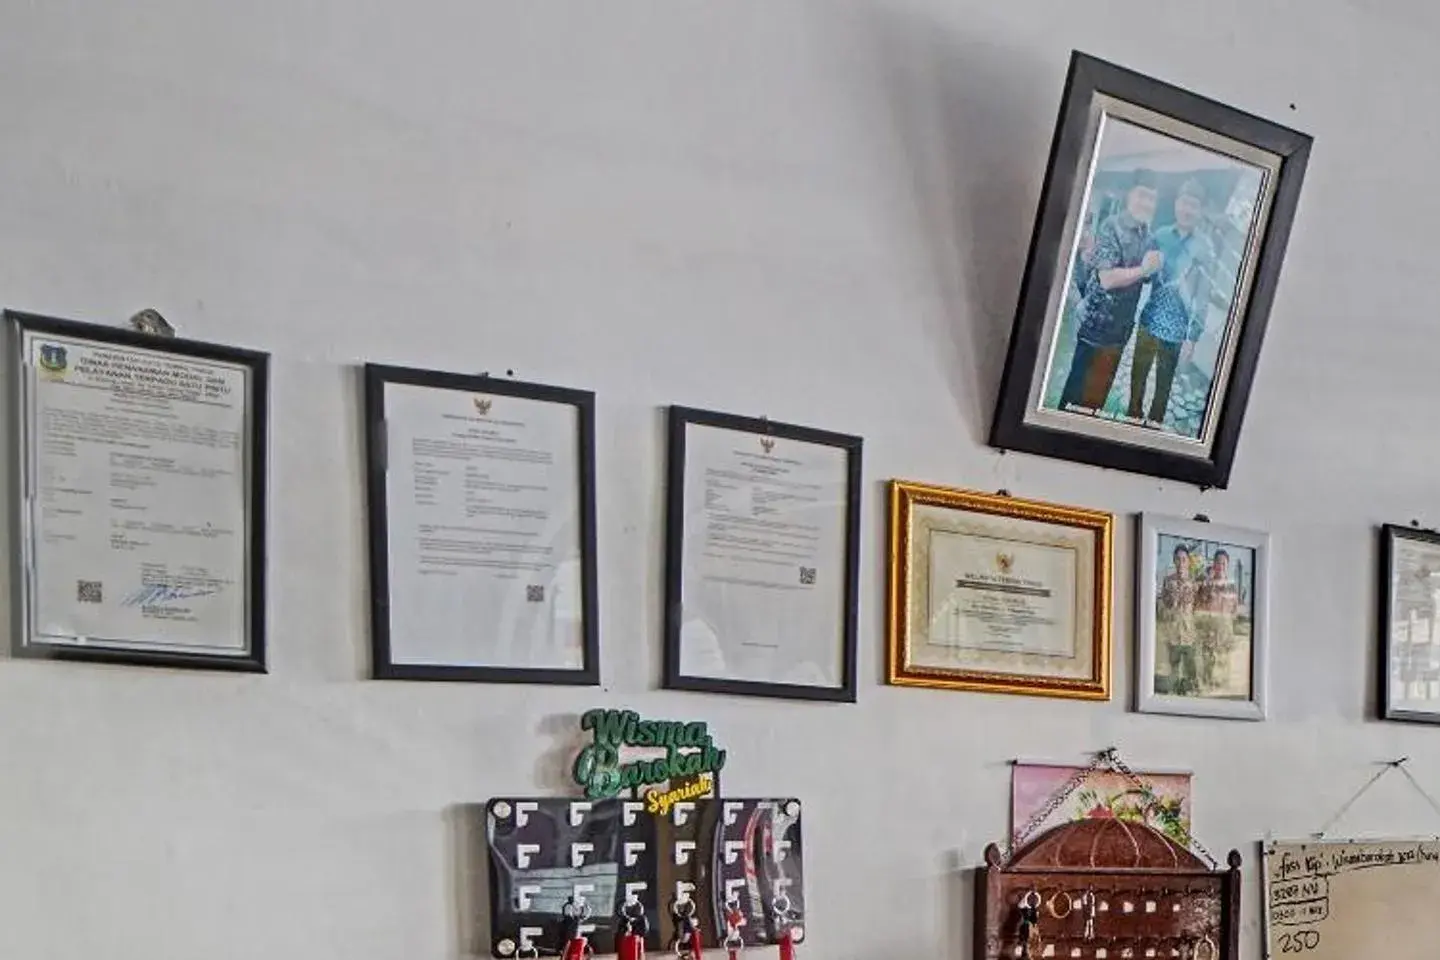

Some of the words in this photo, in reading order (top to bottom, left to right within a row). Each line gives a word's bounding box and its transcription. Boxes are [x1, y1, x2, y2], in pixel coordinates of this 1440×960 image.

[581, 708, 709, 748] Wisma
[573, 735, 726, 800] Barokah
[646, 773, 714, 816] Syariah
[1278, 931, 1321, 953] 250
